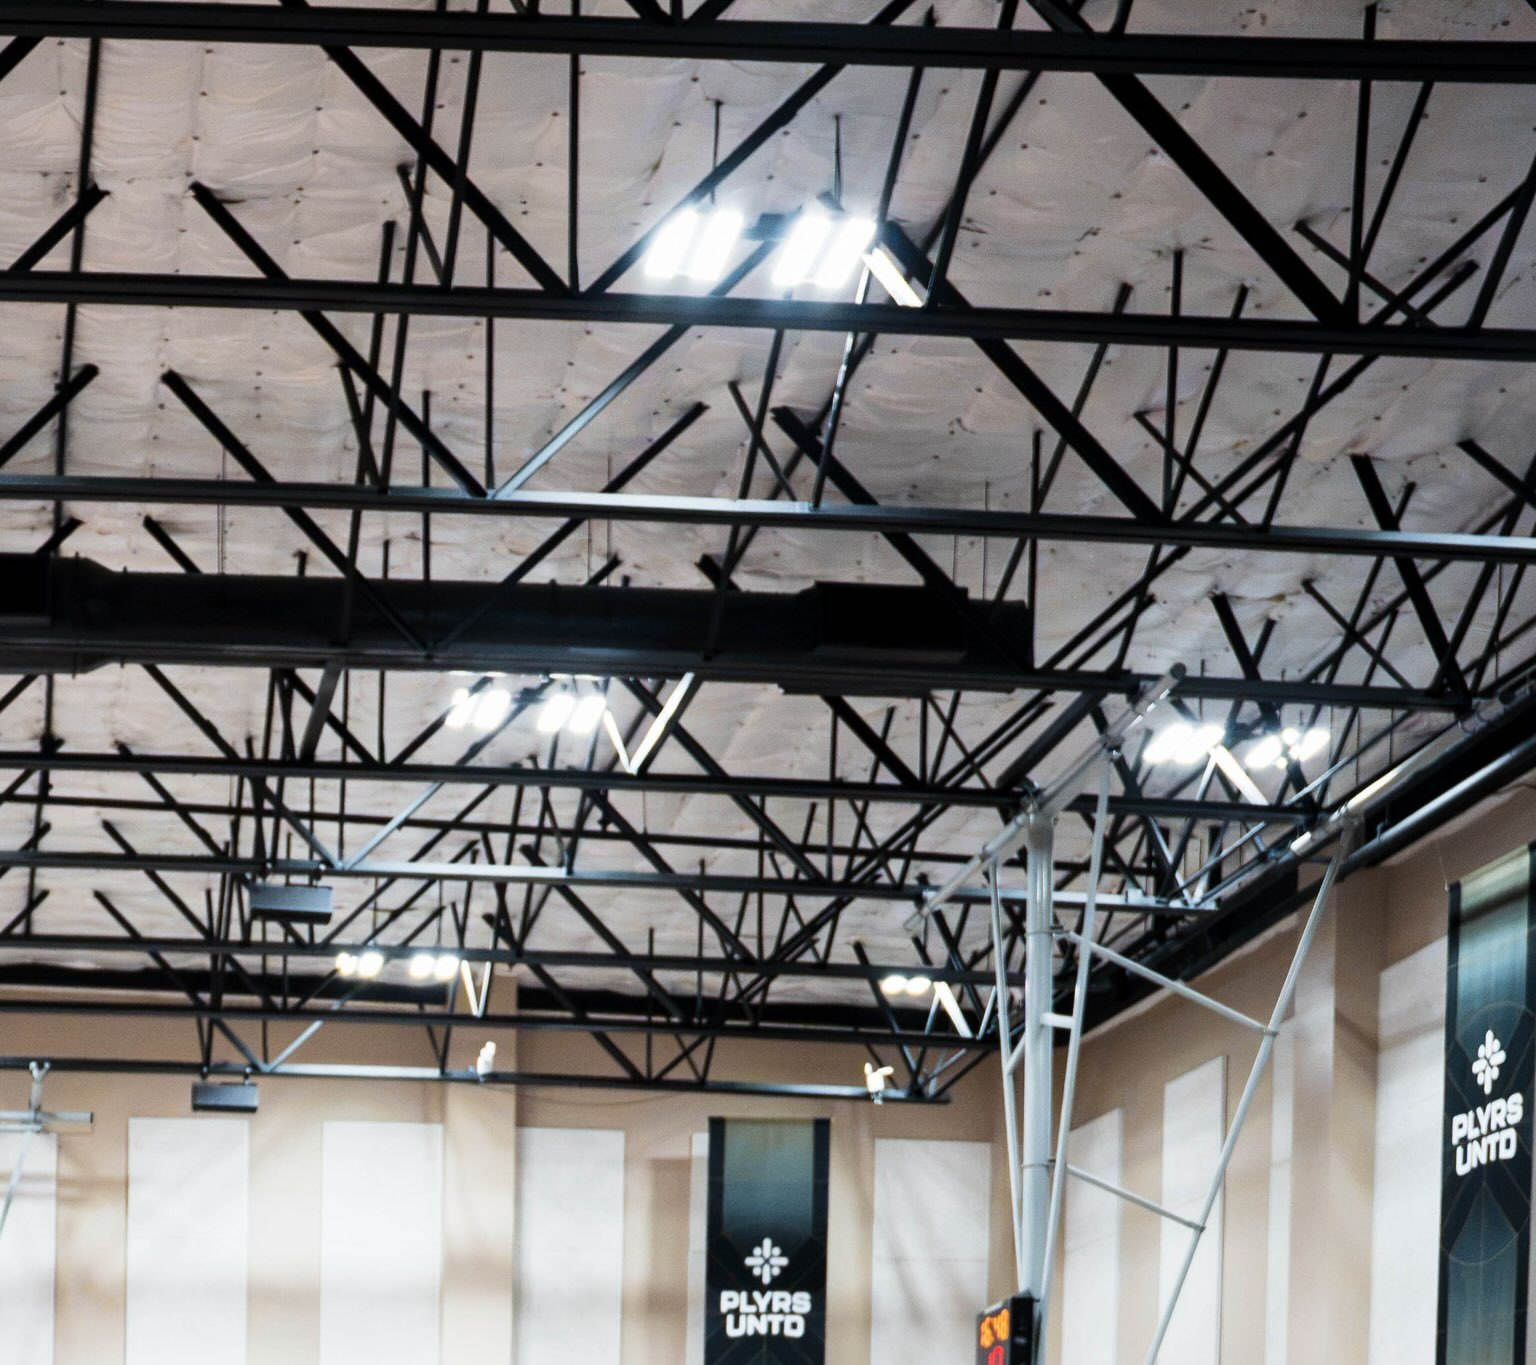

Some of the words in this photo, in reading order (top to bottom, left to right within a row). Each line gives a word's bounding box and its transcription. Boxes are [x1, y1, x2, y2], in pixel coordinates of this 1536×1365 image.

[1451, 1092, 1524, 1146] PLYRS
[1455, 1127, 1517, 1176] UNTD
[720, 1290, 812, 1314] PLYRS
[725, 1313, 805, 1338] UNTD
